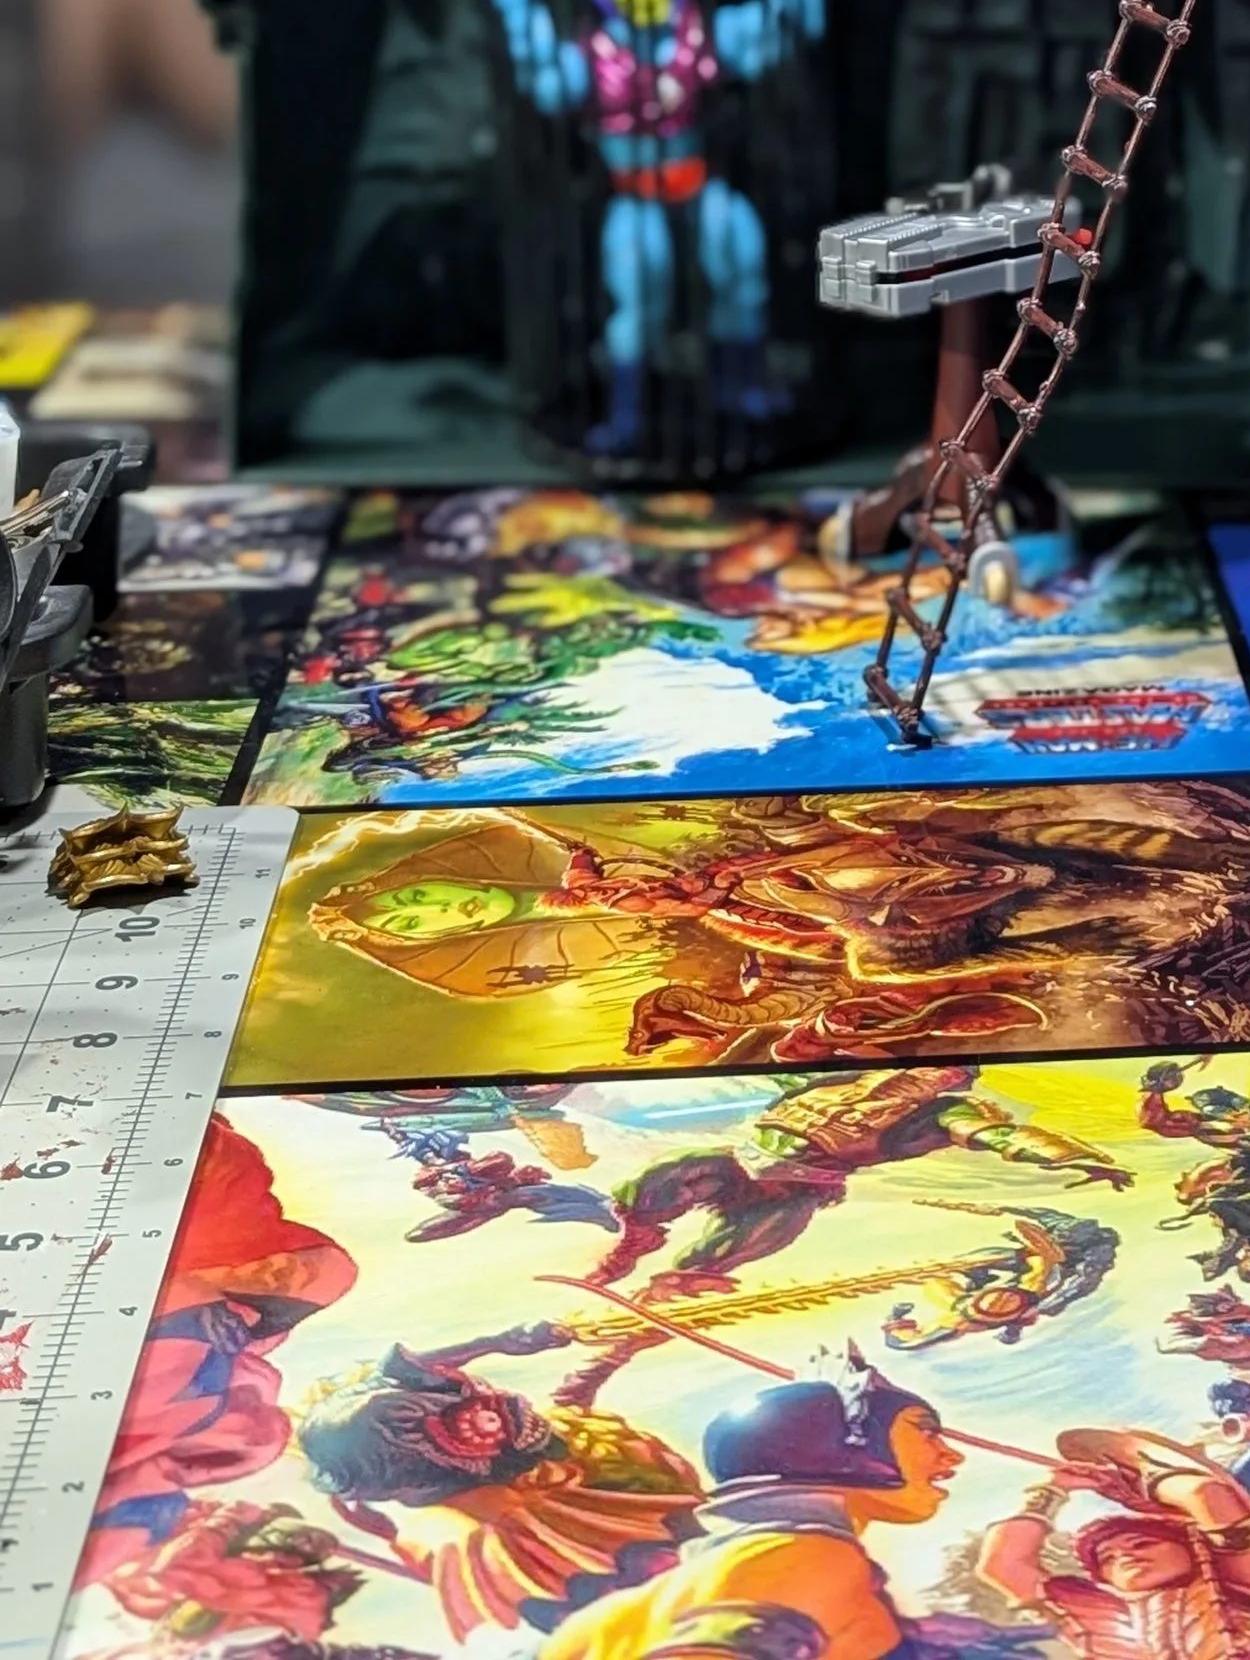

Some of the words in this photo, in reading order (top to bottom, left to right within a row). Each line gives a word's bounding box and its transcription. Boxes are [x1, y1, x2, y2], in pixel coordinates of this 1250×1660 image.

[255, 868, 272, 879] 11
[114, 916, 160, 942] 10
[238, 917, 257, 930] 10
[95, 975, 139, 990] 9
[221, 973, 240, 981] 9
[203, 1030, 223, 1038] 8
[73, 1032, 118, 1048] 8
[184, 1092, 203, 1100] 7
[46, 1095, 94, 1112] 7
[163, 1158, 184, 1167] 6
[23, 1160, 71, 1179] 6
[142, 1229, 162, 1238] 5
[0, 1232, 44, 1251] 5
[118, 1306, 138, 1316] 4
[90, 1390, 113, 1401] 3
[61, 1481, 85, 1494] 2
[31, 1582, 54, 1592] 1
